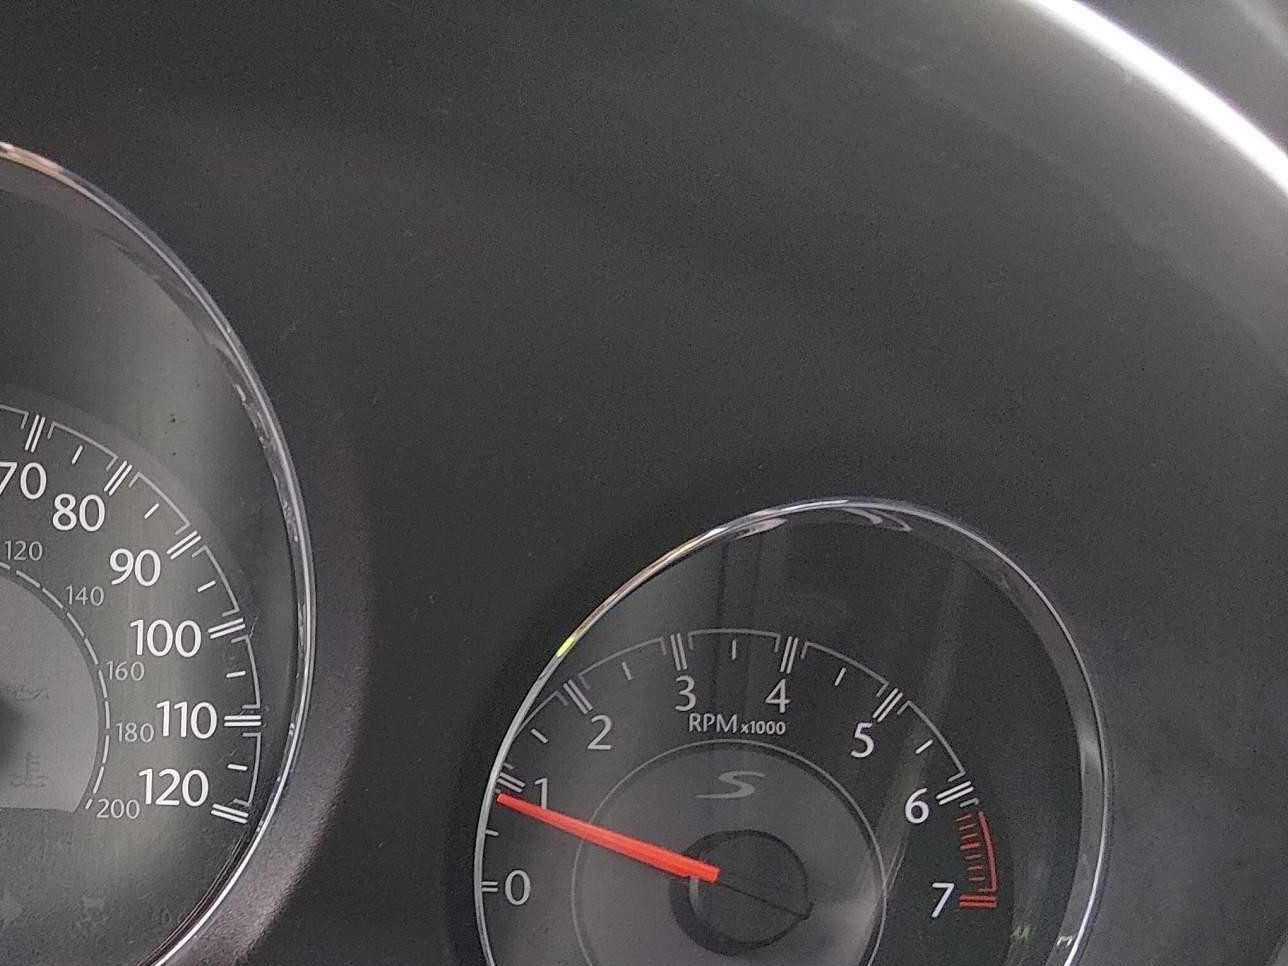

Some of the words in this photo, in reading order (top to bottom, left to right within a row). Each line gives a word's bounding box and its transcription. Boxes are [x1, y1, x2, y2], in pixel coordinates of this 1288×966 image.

[53, 494, 105, 531] 80
[5, 541, 42, 560] 120
[110, 549, 160, 586] 90
[67, 586, 104, 606] 140
[131, 620, 201, 657] 100
[107, 661, 144, 681] 160
[676, 676, 696, 711] 3
[766, 679, 790, 713] 4
[117, 723, 154, 742] 180
[157, 701, 217, 738] 110
[588, 715, 611, 749] 2
[689, 713, 737, 733] RPM
[851, 723, 874, 757] 5
[139, 769, 208, 806] 120
[534, 778, 548, 808] 1
[97, 799, 139, 819] 200
[906, 788, 929, 823] 6
[505, 870, 531, 905] 0
[932, 883, 954, 917] 7
